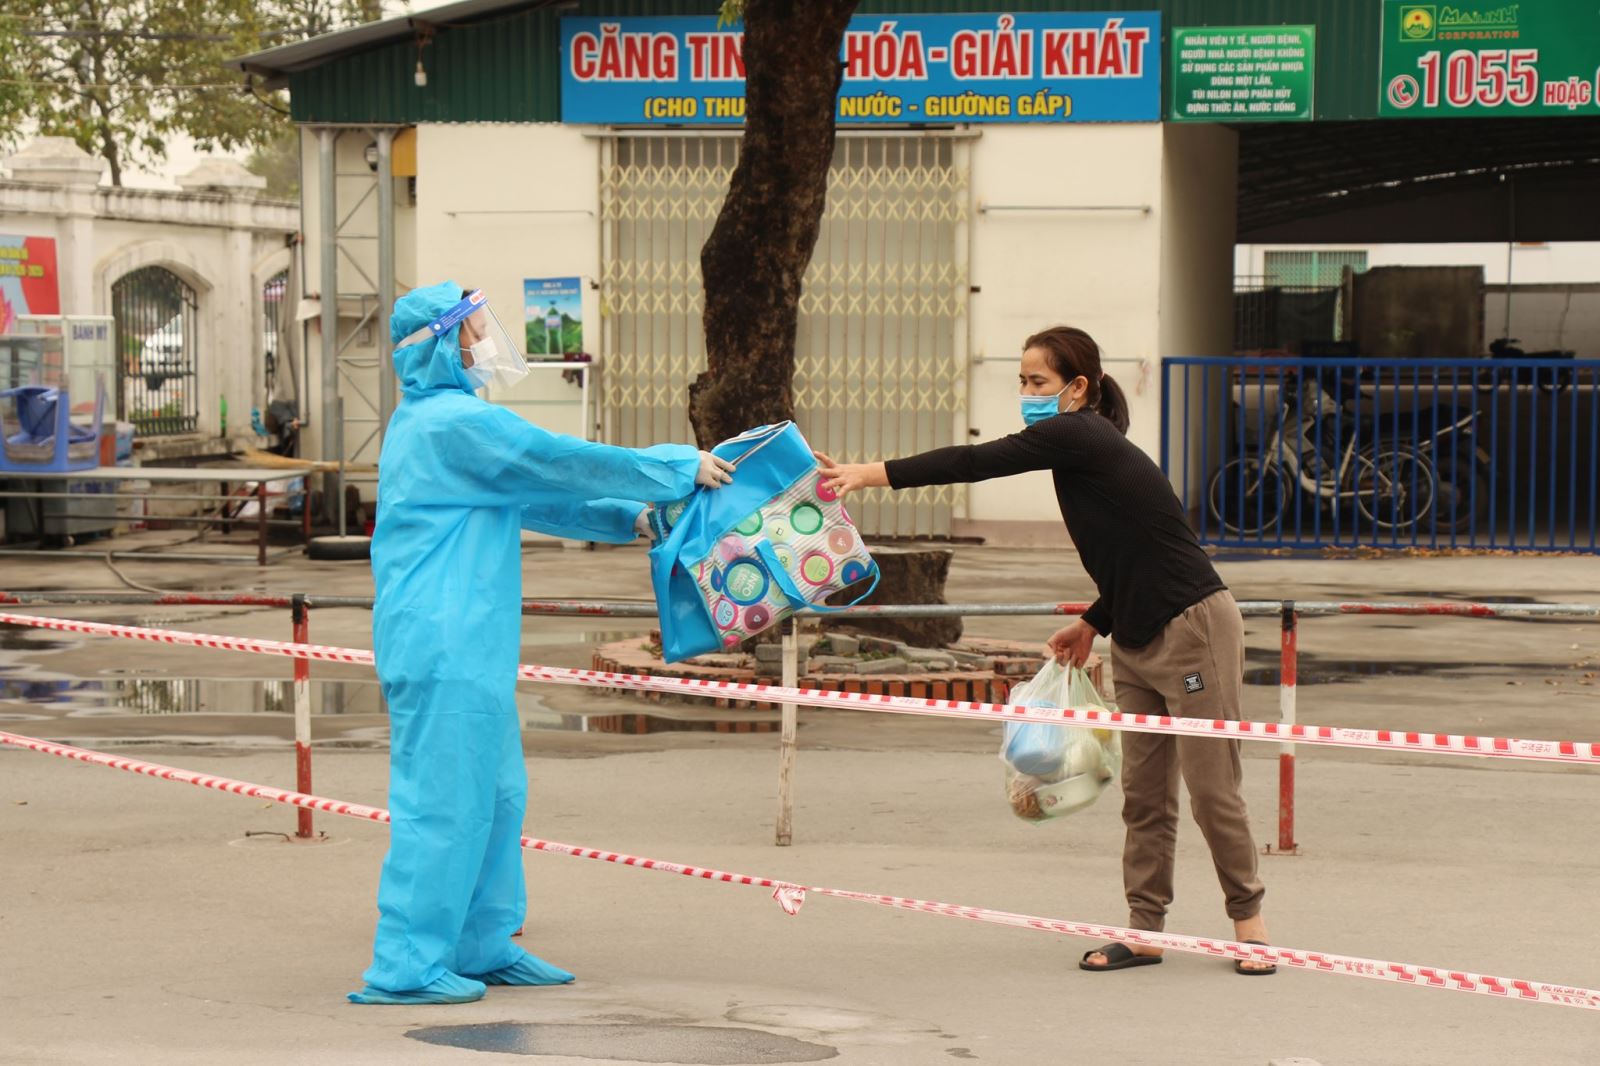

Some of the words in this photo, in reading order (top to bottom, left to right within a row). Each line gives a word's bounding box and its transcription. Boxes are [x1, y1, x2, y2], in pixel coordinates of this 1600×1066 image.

[1184, 34, 1208, 46] NHÂN
[1209, 34, 1228, 46] VIÊN
[1229, 34, 1236, 46] Y
[1438, 30, 1520, 40] CORPORATION
[571, 22, 679, 82] CĂNG
[686, 31, 746, 82] TIN
[1042, 18, 1149, 79] KHÁT
[1277, 48, 1305, 59] KHÔNG
[1218, 62, 1235, 74] CÁC
[1417, 48, 1538, 108] 1055
[1543, 76, 1592, 110] HOẶC
[1206, 87, 1231, 99] NILON
[1250, 87, 1273, 99] PHÂN
[643, 97, 697, 119] (CHO
[704, 97, 746, 117] THU
[840, 90, 902, 116] NƯỚC
[925, 90, 1011, 116] GIƯỜNG
[1017, 87, 1072, 117] GẤP)
